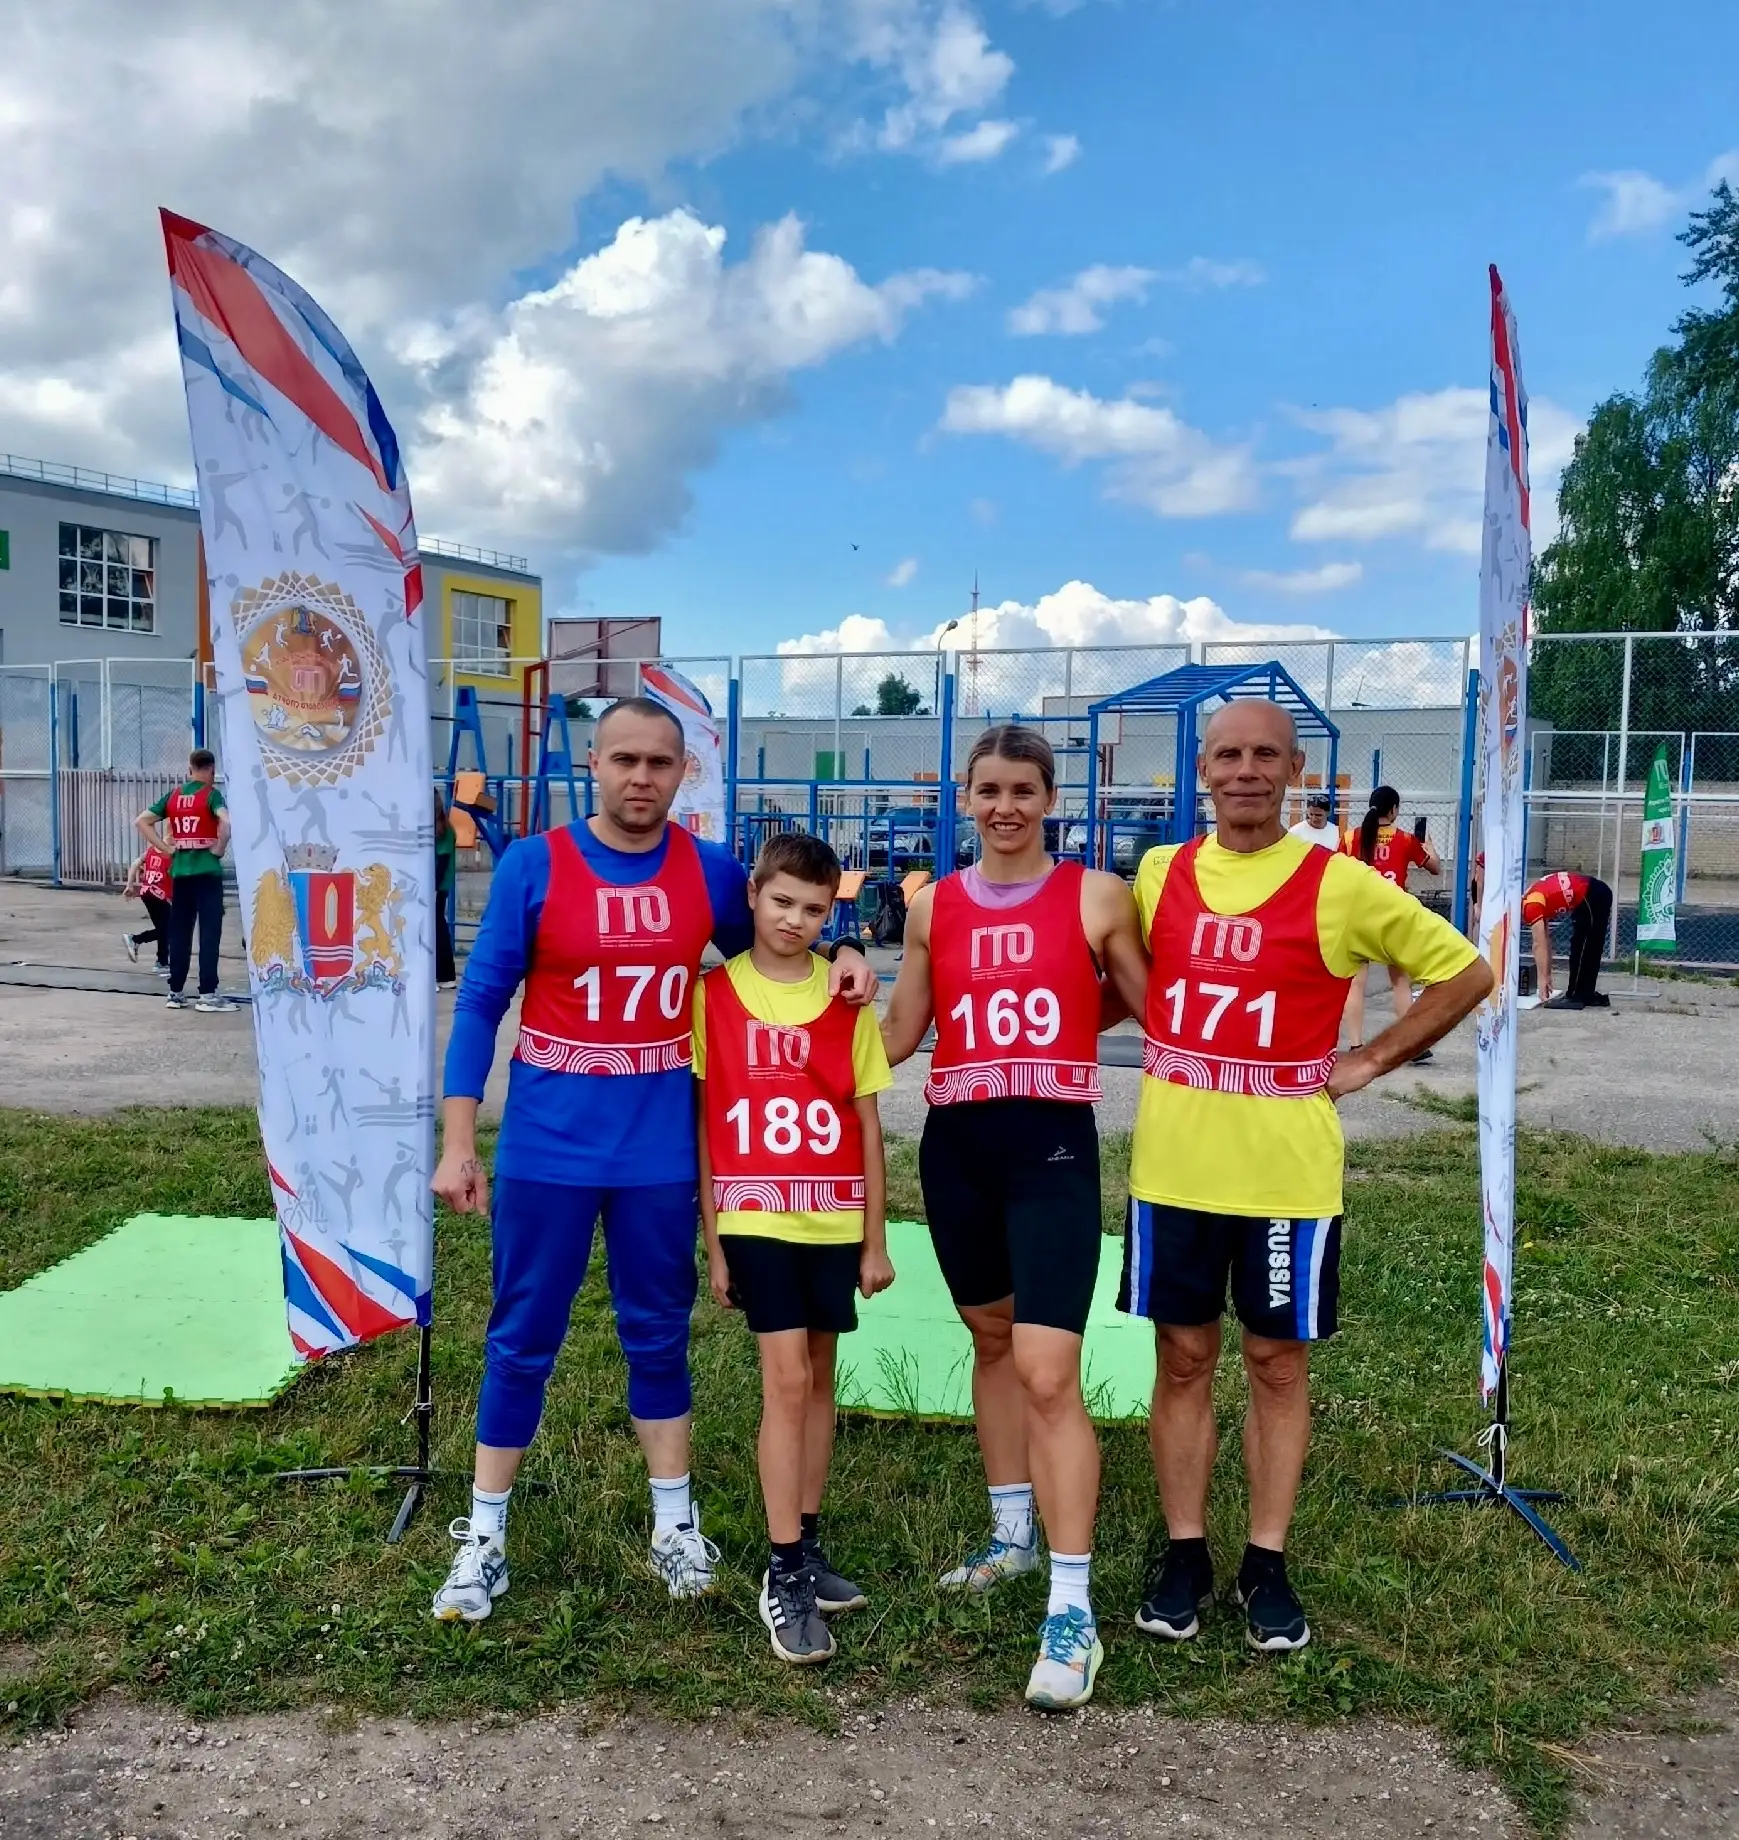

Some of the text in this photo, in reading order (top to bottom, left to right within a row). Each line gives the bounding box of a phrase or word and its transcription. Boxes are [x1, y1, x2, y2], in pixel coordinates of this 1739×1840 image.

[174, 815, 200, 833] 187
[176, 794, 196, 808] ГТО
[596, 886, 671, 935] ГТО
[1190, 911, 1264, 963] ГТО
[970, 922, 1034, 969] ГТО
[573, 964, 690, 1022] 170
[950, 986, 1062, 1051] 169
[1164, 977, 1277, 1049] 171
[746, 1018, 811, 1071] ГТО
[725, 1096, 842, 1156] 189
[1267, 1218, 1292, 1309] RUSSIA
